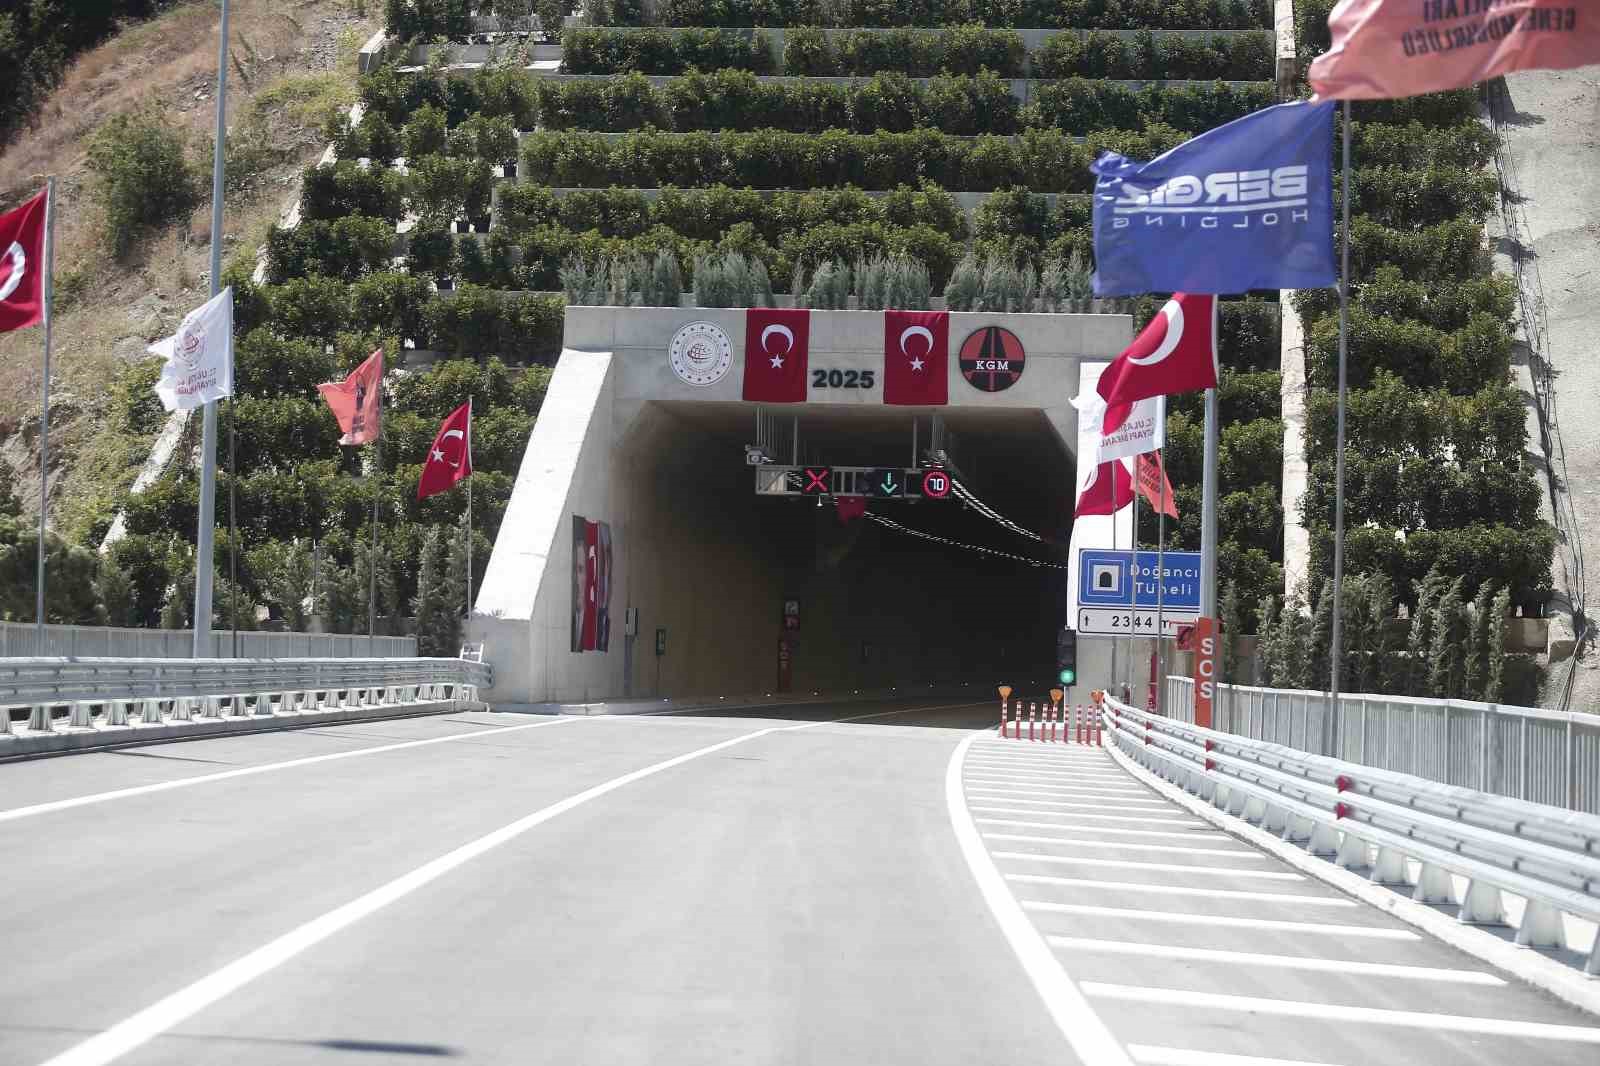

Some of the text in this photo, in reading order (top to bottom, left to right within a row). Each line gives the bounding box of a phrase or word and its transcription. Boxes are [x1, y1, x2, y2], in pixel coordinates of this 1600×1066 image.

[975, 359, 1009, 371] KGM
[812, 369, 875, 389] 2025
[930, 478, 944, 491] 70
[1130, 563, 1198, 580] Doğancı
[1111, 615, 1153, 629] 2344
[1200, 637, 1214, 699] SOS
